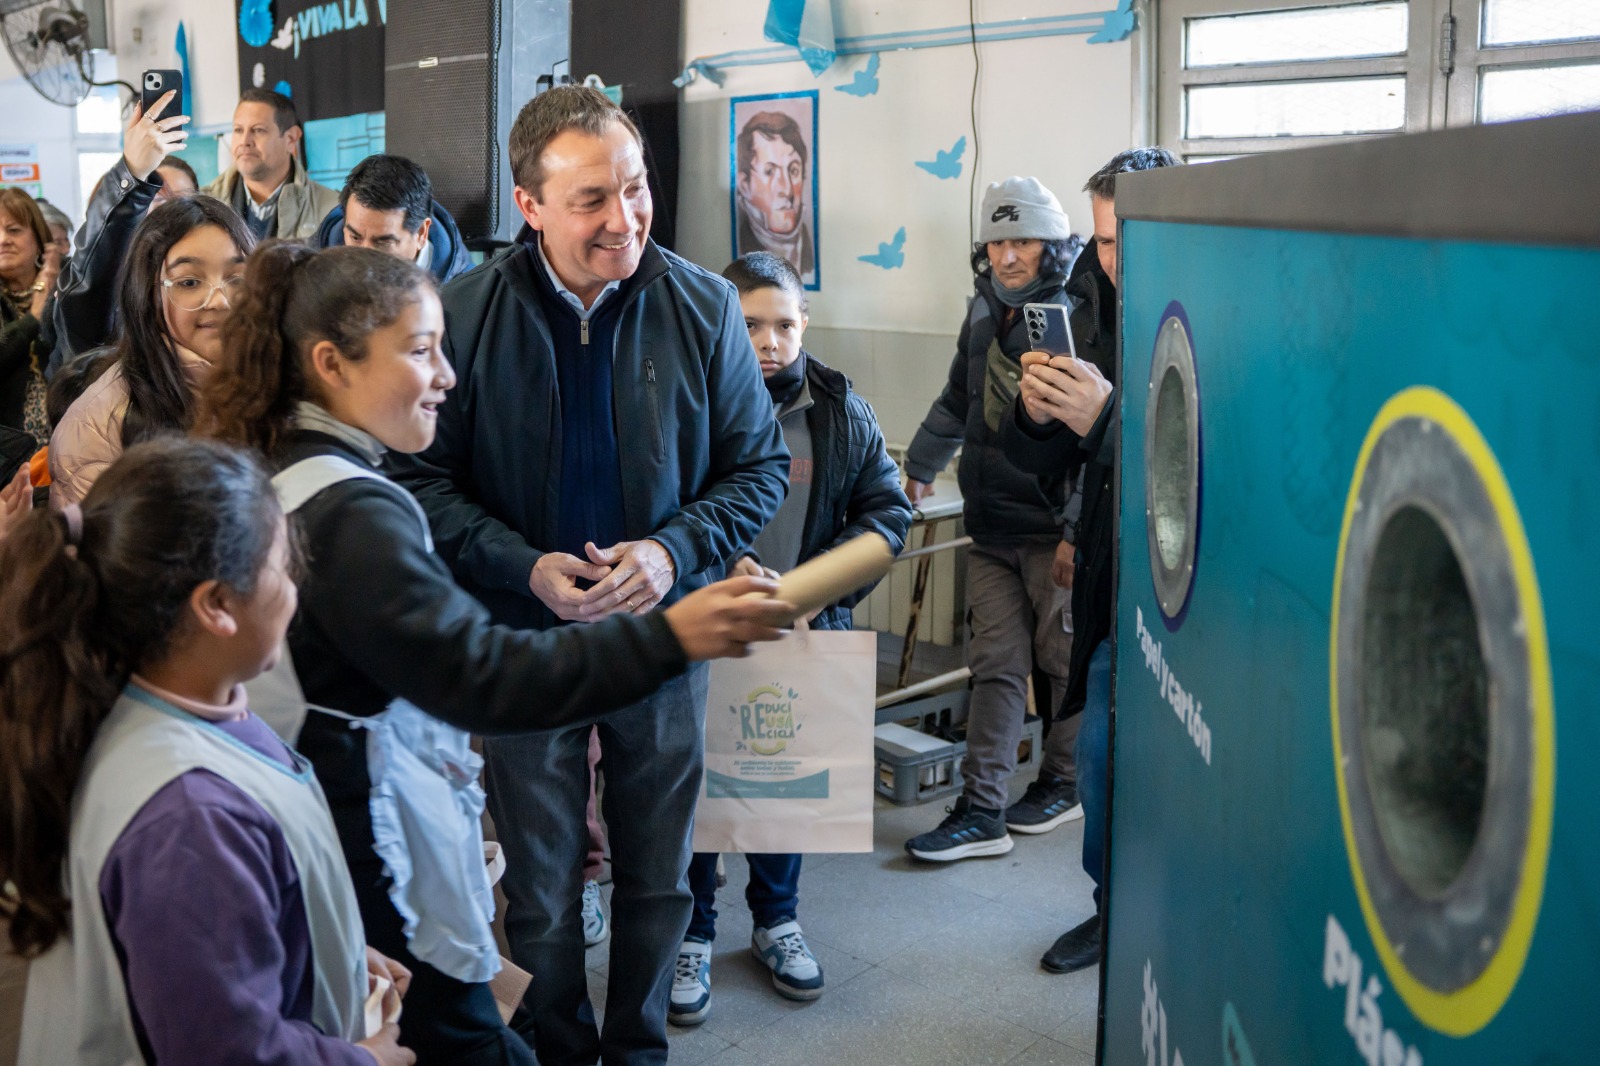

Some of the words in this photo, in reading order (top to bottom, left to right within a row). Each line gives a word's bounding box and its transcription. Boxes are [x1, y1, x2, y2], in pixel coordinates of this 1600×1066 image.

[343, 0, 369, 30] LA
[1136, 605, 1162, 682] Papel
[1160, 657, 1169, 699] y
[1167, 672, 1212, 767] cartón
[1323, 913, 1423, 1066] Plá
